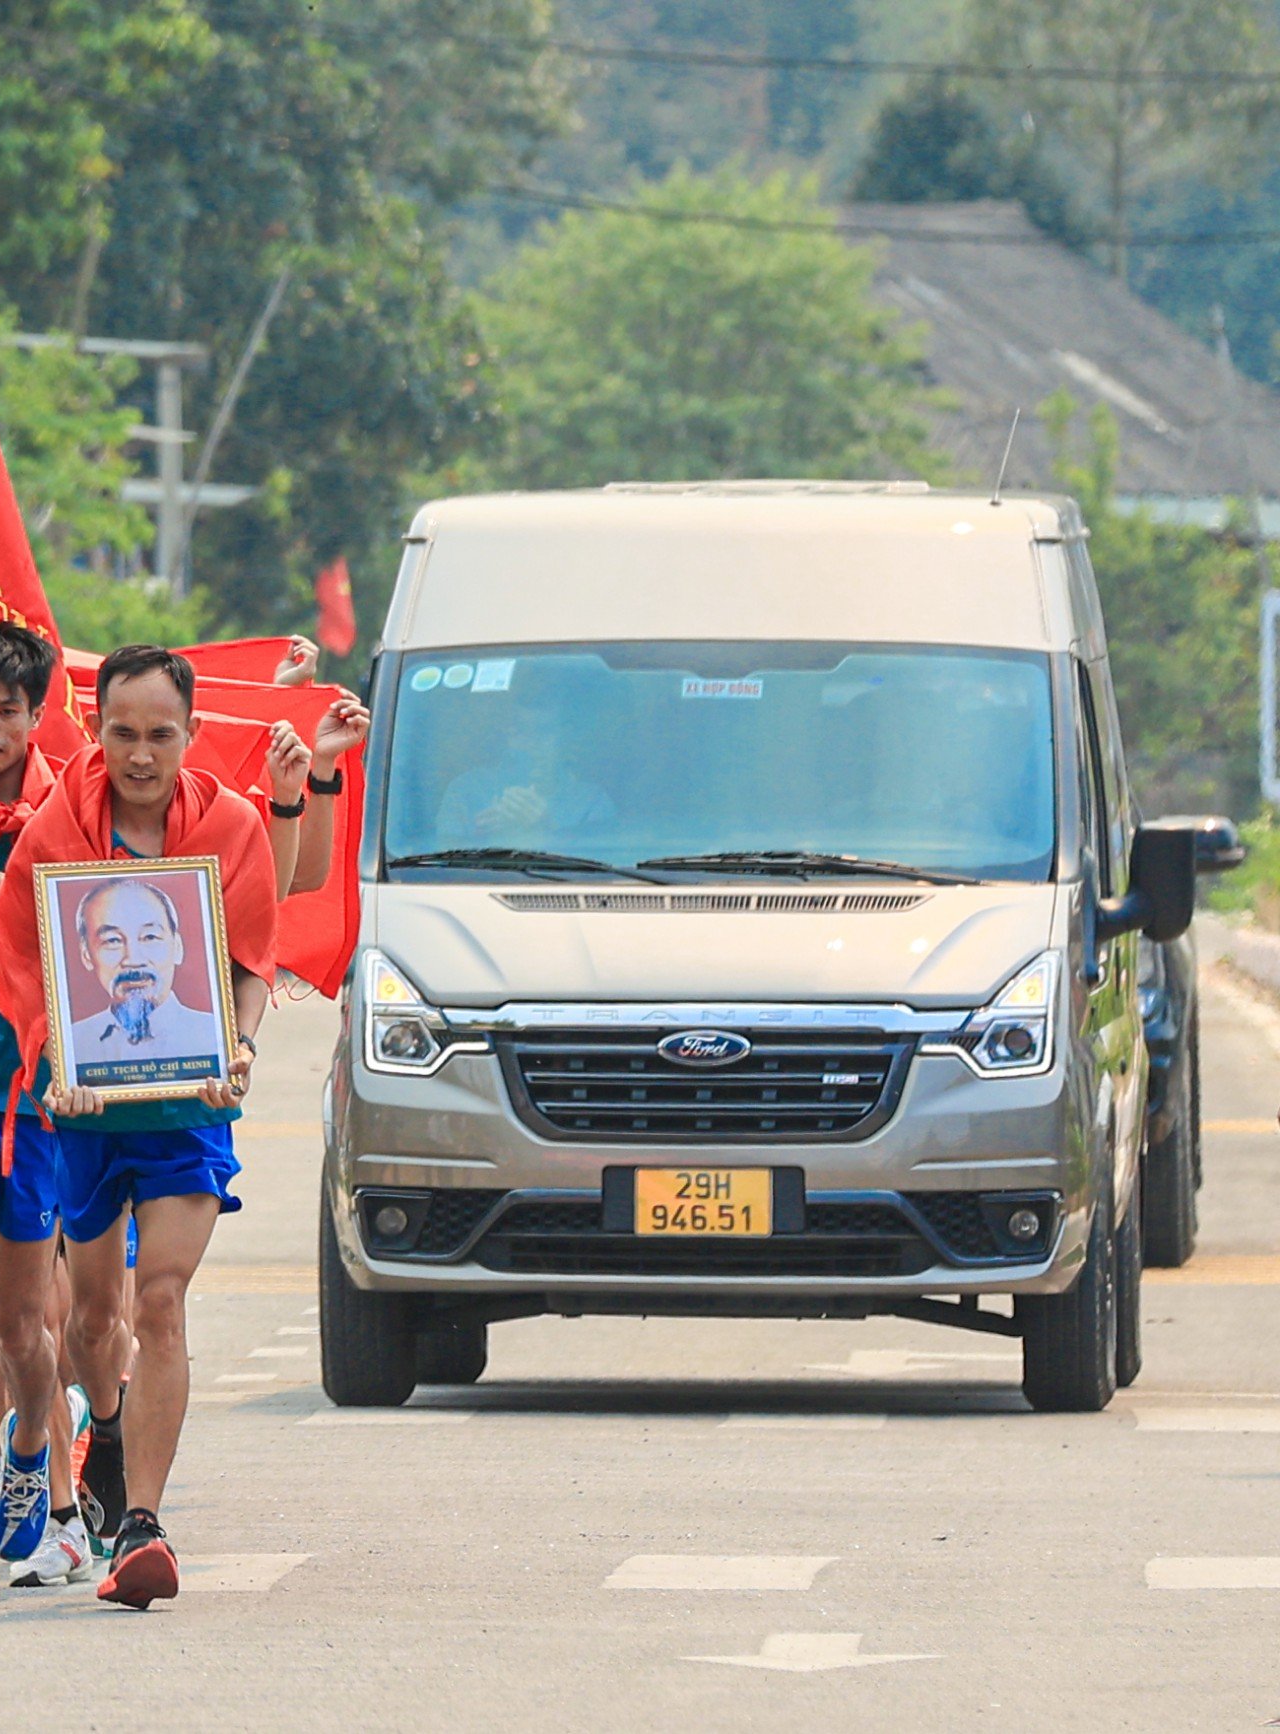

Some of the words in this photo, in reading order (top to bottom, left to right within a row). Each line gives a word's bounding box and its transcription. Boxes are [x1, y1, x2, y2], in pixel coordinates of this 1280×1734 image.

[532, 1008, 878, 1022] TRANSIT
[680, 1035, 729, 1058] Ford
[86, 1065, 109, 1077] CHỦ
[112, 1064, 138, 1075] TỊCH
[141, 1062, 157, 1072] HỒ
[160, 1060, 179, 1071] CHÍ
[182, 1060, 211, 1069] MINH
[675, 1173, 732, 1200] 29H
[651, 1204, 752, 1231] 946.51
